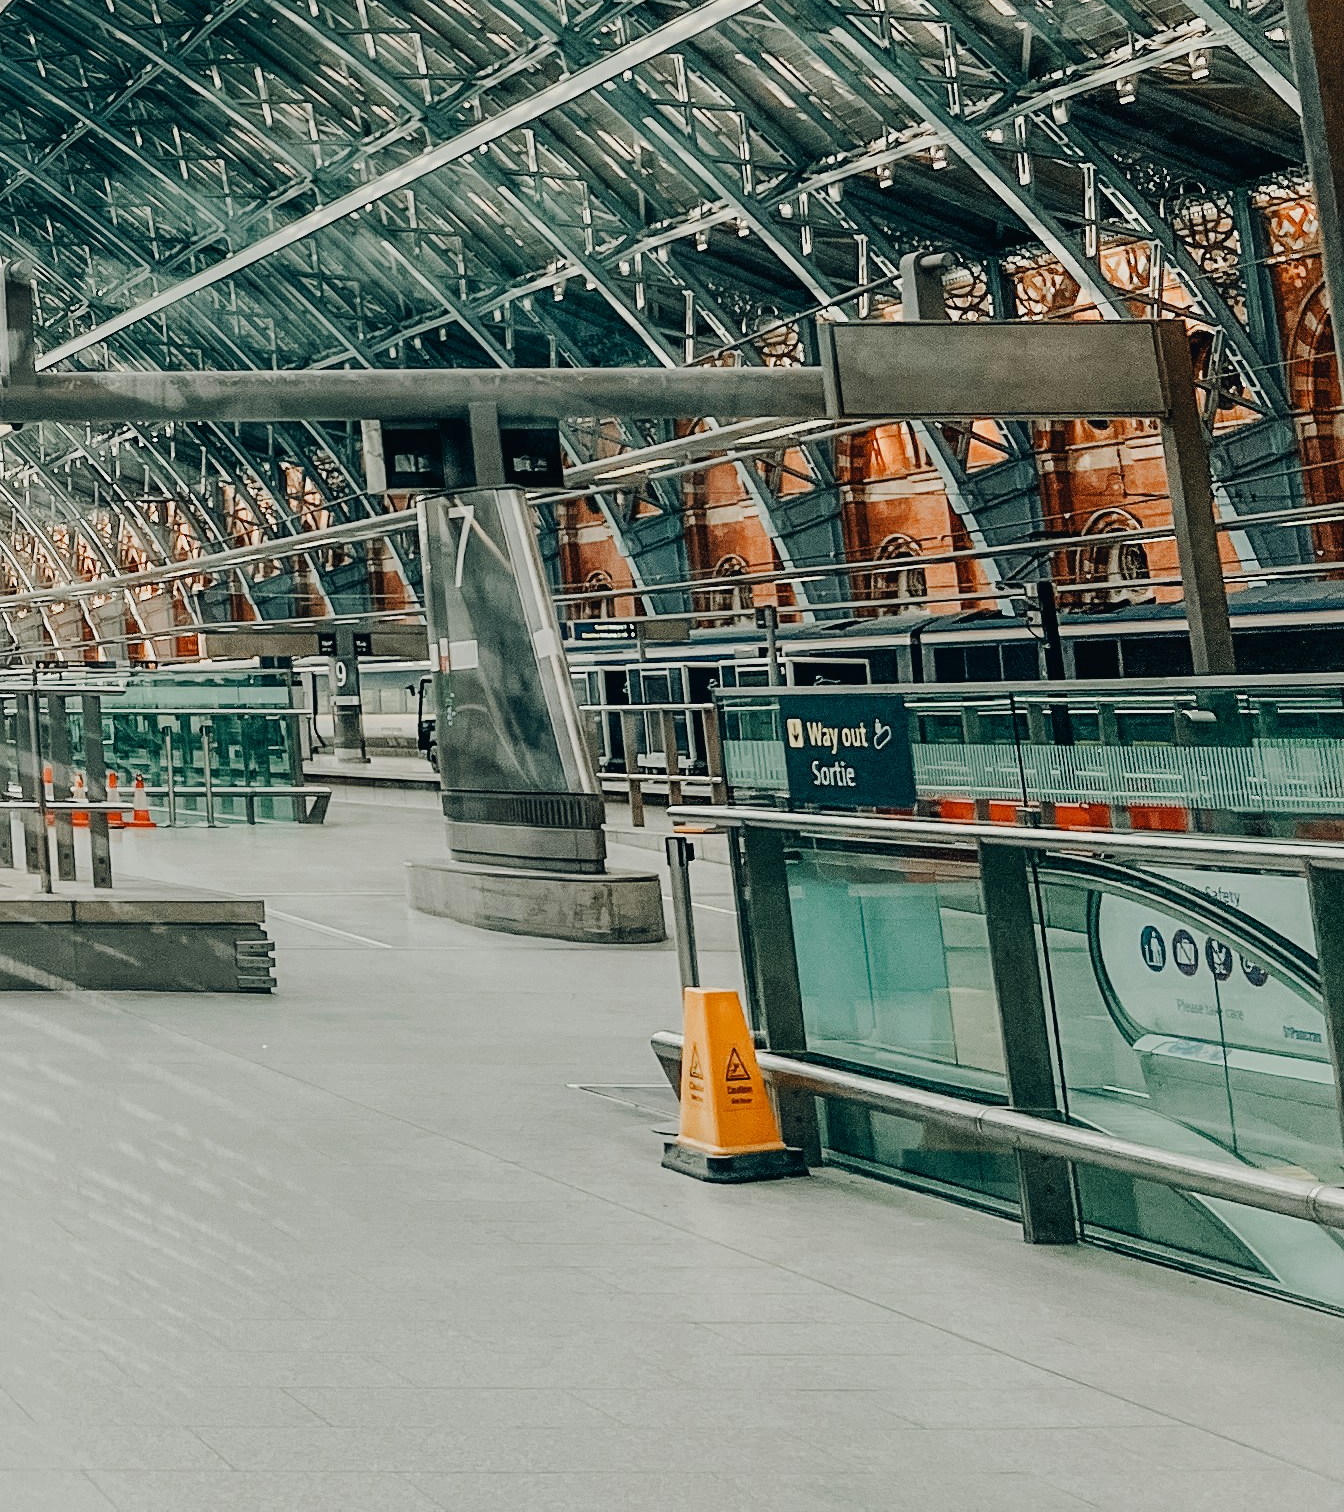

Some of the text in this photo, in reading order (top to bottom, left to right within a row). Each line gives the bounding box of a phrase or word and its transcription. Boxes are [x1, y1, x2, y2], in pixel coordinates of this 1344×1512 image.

[448, 504, 475, 588] 7
[335, 661, 347, 687] 9
[806, 721, 869, 755] Way out
[812, 760, 857, 787] Sortie
